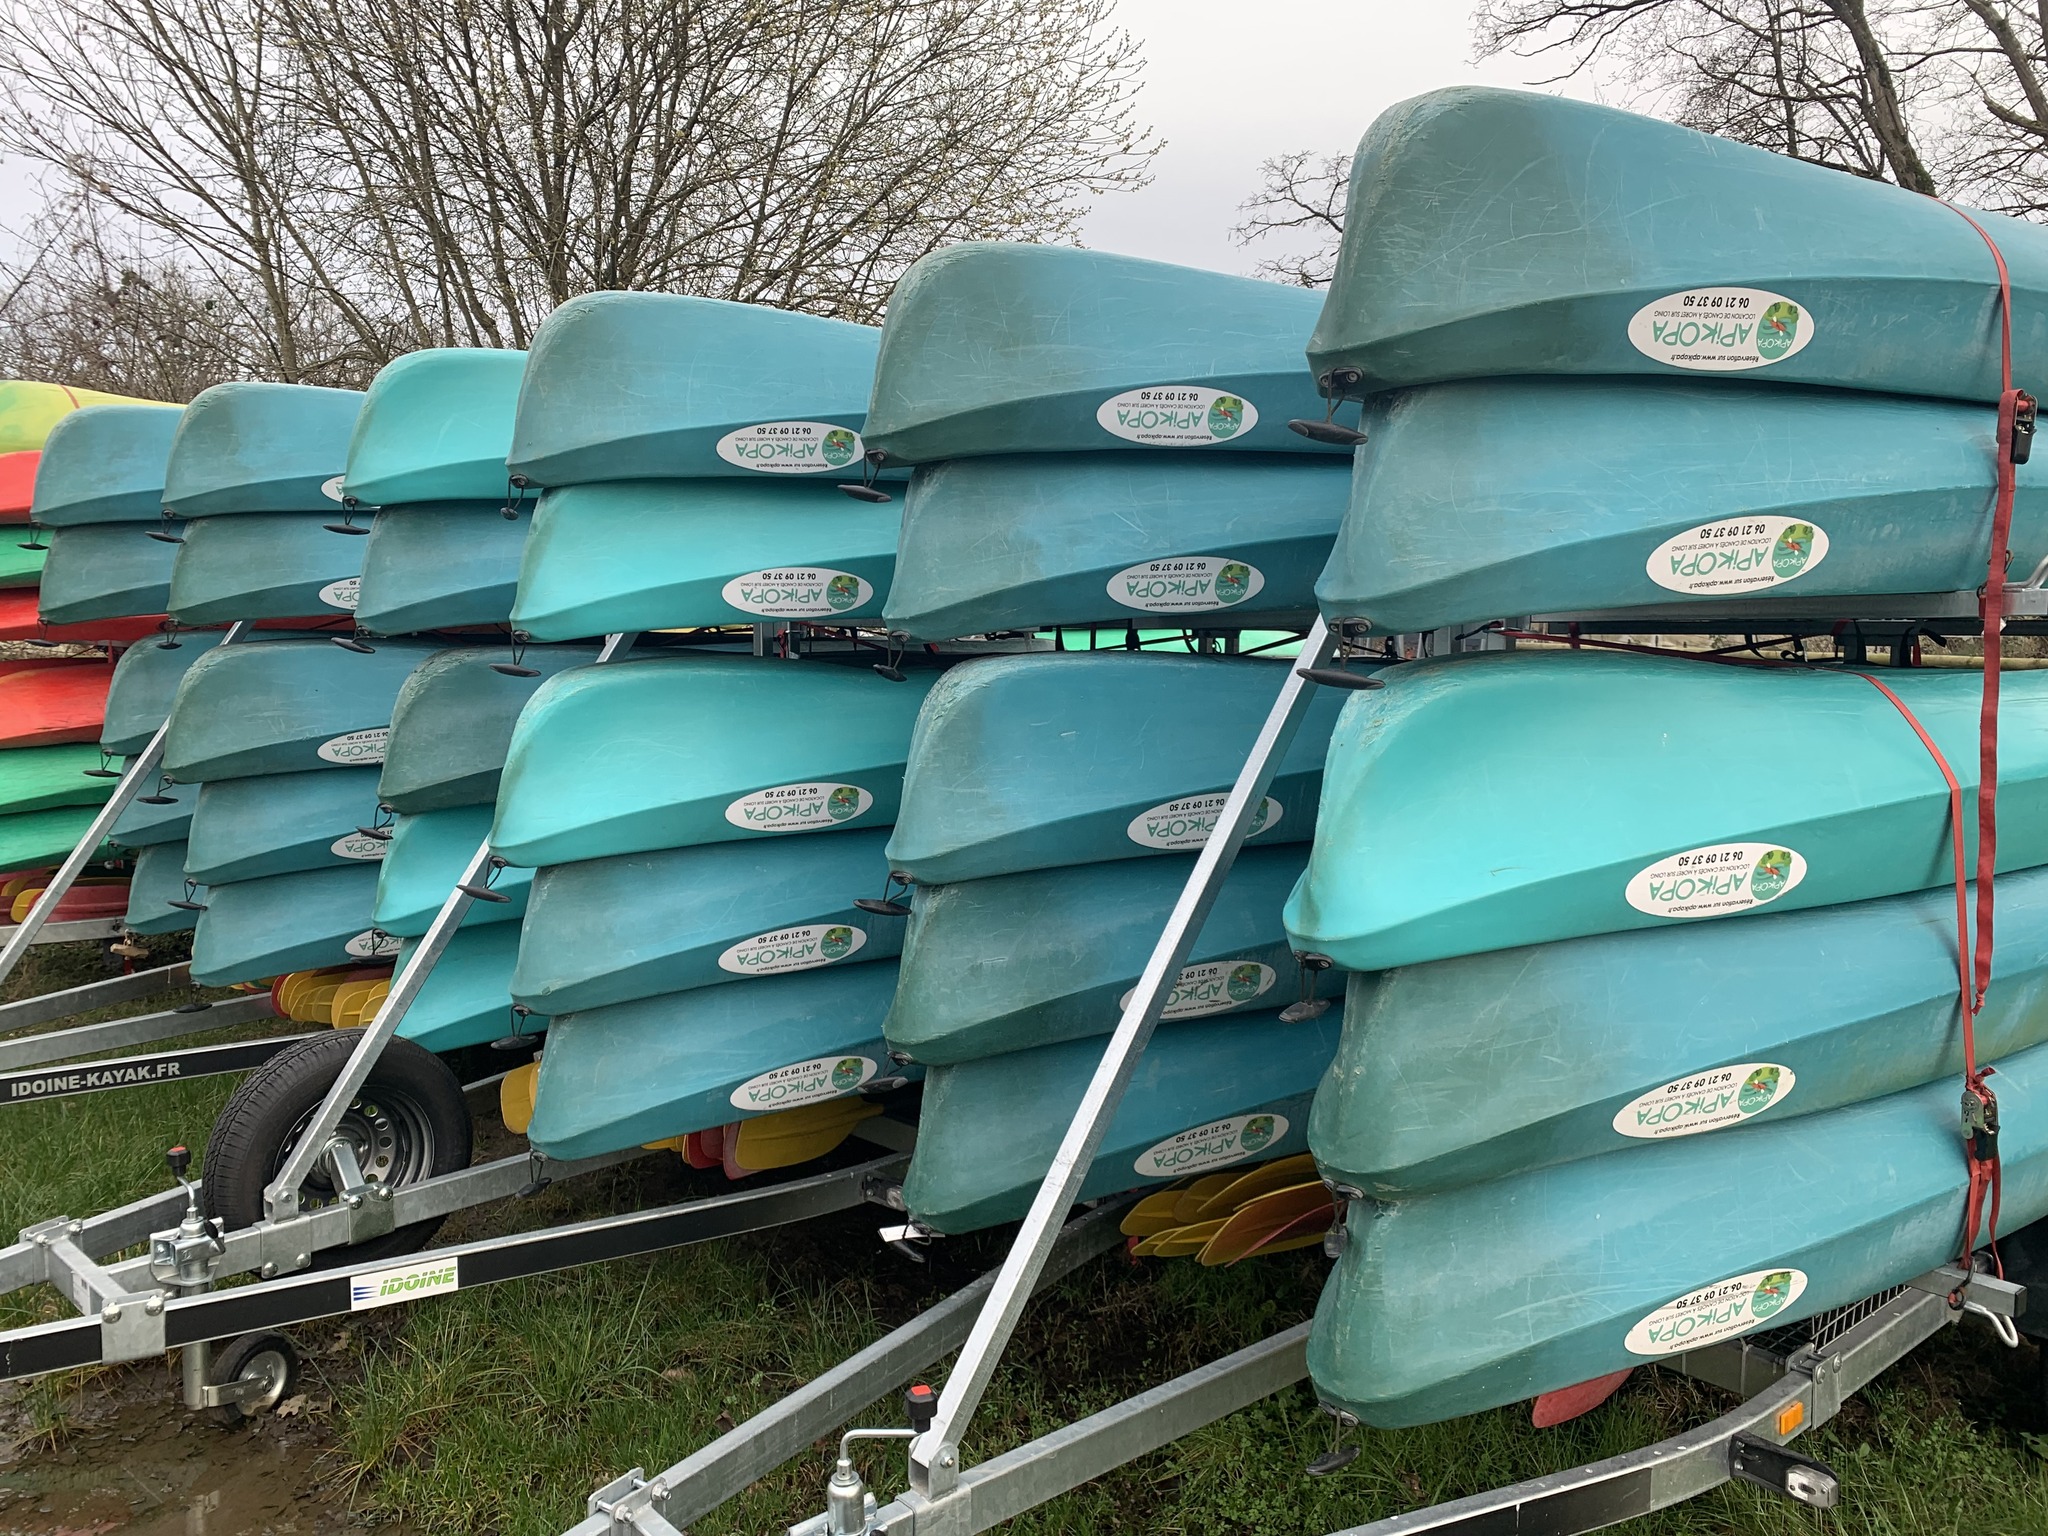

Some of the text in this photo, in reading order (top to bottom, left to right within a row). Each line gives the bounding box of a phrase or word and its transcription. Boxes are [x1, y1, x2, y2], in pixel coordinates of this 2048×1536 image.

[1684, 296, 1749, 308] 06 21 09 37 50
[1152, 392, 1164, 400] 37
[1164, 392, 1175, 400] 09
[1188, 393, 1199, 401] 06
[1701, 524, 1765, 539] 06 21 09 37 50
[1173, 563, 1184, 571] 09
[1180, 802, 1191, 810] 37
[1192, 801, 1202, 809] 09
[1678, 851, 1743, 866] 06 21 09 37 50
[1185, 971, 1195, 979] 09
[1197, 969, 1207, 977] 21
[11, 1062, 181, 1098] IDOINE-KAYAK.FR
[768, 1072, 779, 1080] 50
[1668, 1073, 1731, 1093] 06 21 09 37 50
[1176, 1123, 1231, 1143] 06 21 09 37 50
[1676, 1282, 1742, 1310] 06 21 09 37 50
